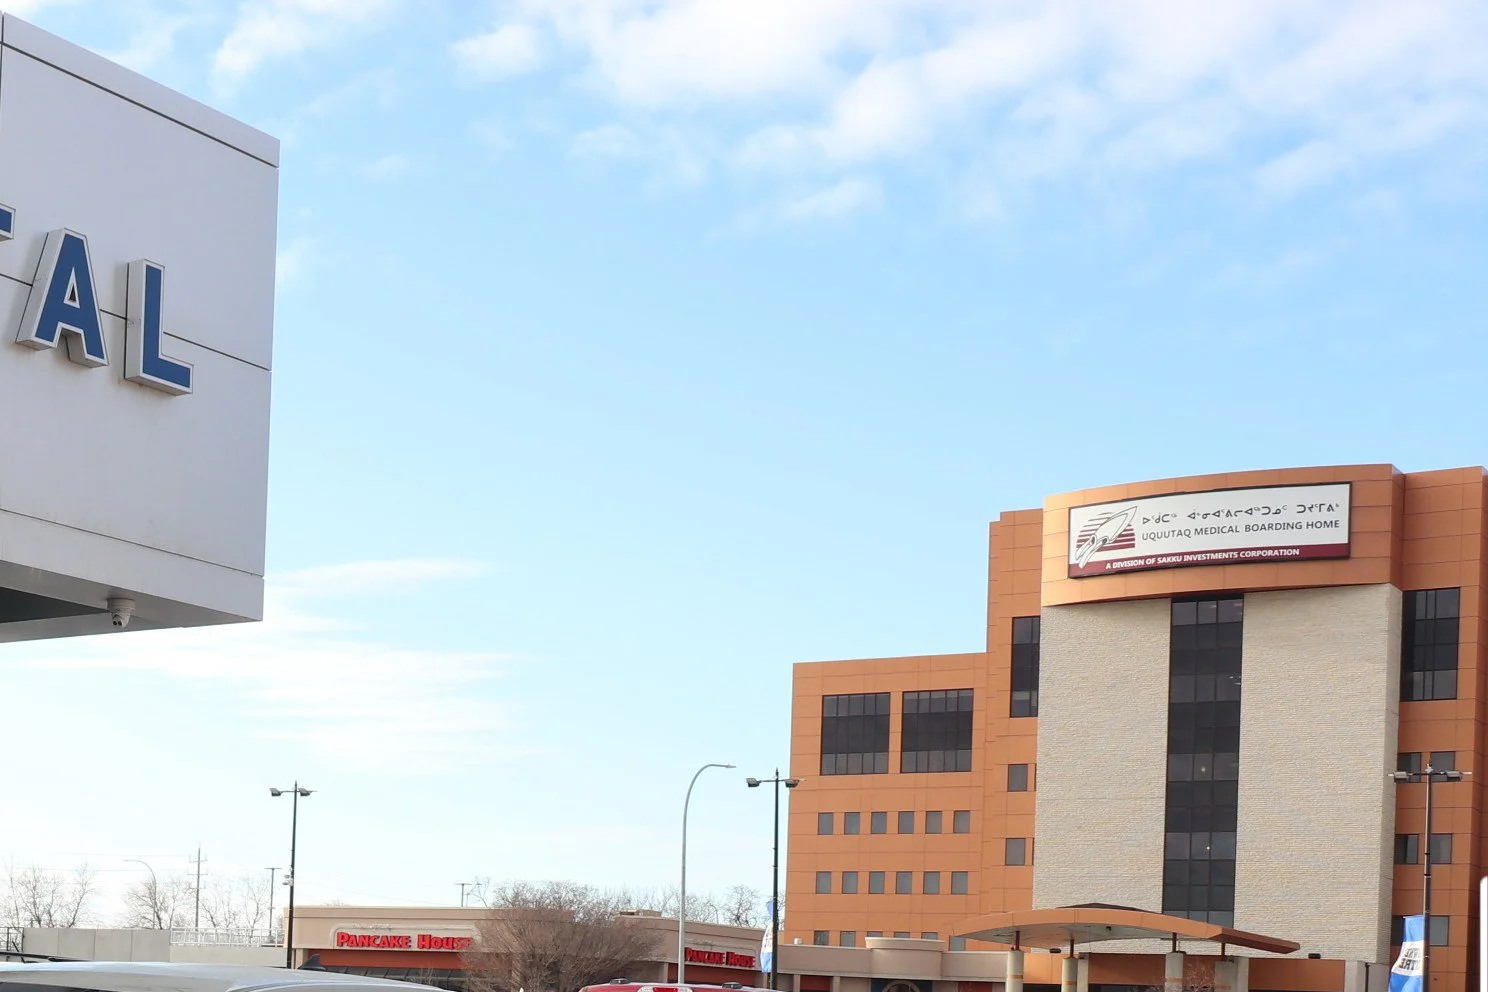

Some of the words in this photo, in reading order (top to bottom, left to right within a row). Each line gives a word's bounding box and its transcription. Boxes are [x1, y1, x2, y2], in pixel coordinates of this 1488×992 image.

[1142, 528, 1192, 541] UQUUTAQ
[1194, 525, 1240, 536] MEDICAL
[1244, 521, 1302, 533] BOARDING
[1306, 520, 1340, 529] HOME
[1105, 562, 1111, 570] A
[1112, 559, 1144, 569] DIVISION
[1146, 557, 1156, 565] OF
[1157, 555, 1182, 564] SAKKU
[1183, 551, 1238, 562] INVESTMENTS
[1239, 548, 1300, 558] CORPORATION
[337, 931, 411, 948] PANCAKE
[684, 946, 725, 965] PANCAKE
[726, 951, 756, 968] HOUSE
